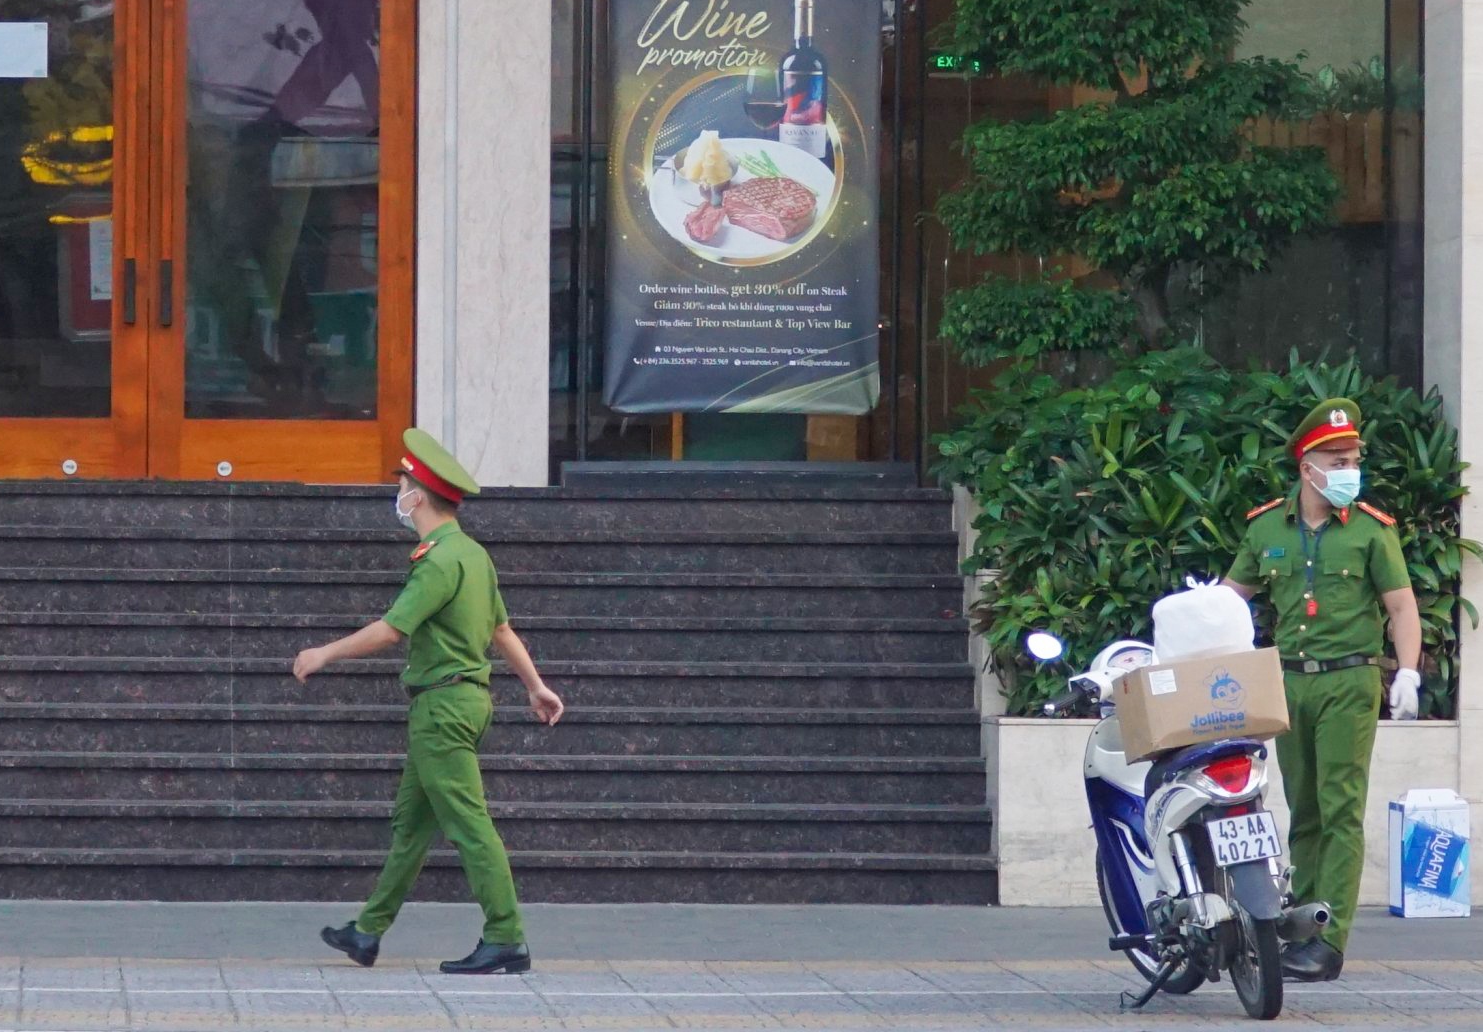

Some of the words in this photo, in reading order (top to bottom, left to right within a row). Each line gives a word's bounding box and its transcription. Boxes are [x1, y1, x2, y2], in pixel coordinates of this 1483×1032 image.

[637, 38, 771, 75] promotion
[639, 284, 668, 294] Order
[670, 284, 692, 294] wine
[694, 284, 729, 295] bottles,
[730, 284, 751, 298] get
[754, 283, 784, 295] 30%
[787, 283, 807, 296] off
[807, 288, 819, 296] on
[821, 286, 848, 296] Steak
[682, 300, 705, 310] 30%
[706, 302, 727, 310] steak
[740, 302, 753, 310] khi
[796, 305, 814, 313] vang
[815, 303, 832, 311] chai
[694, 317, 720, 327] Trico
[775, 319, 783, 328] &
[785, 319, 805, 331] Top
[807, 319, 831, 328] View
[834, 319, 852, 329] Bar
[1190, 710, 1245, 729] Jollibee
[1219, 815, 1266, 840] 43-AA
[1218, 835, 1279, 863] 402.21
[1417, 827, 1453, 889] AQUAFINA
